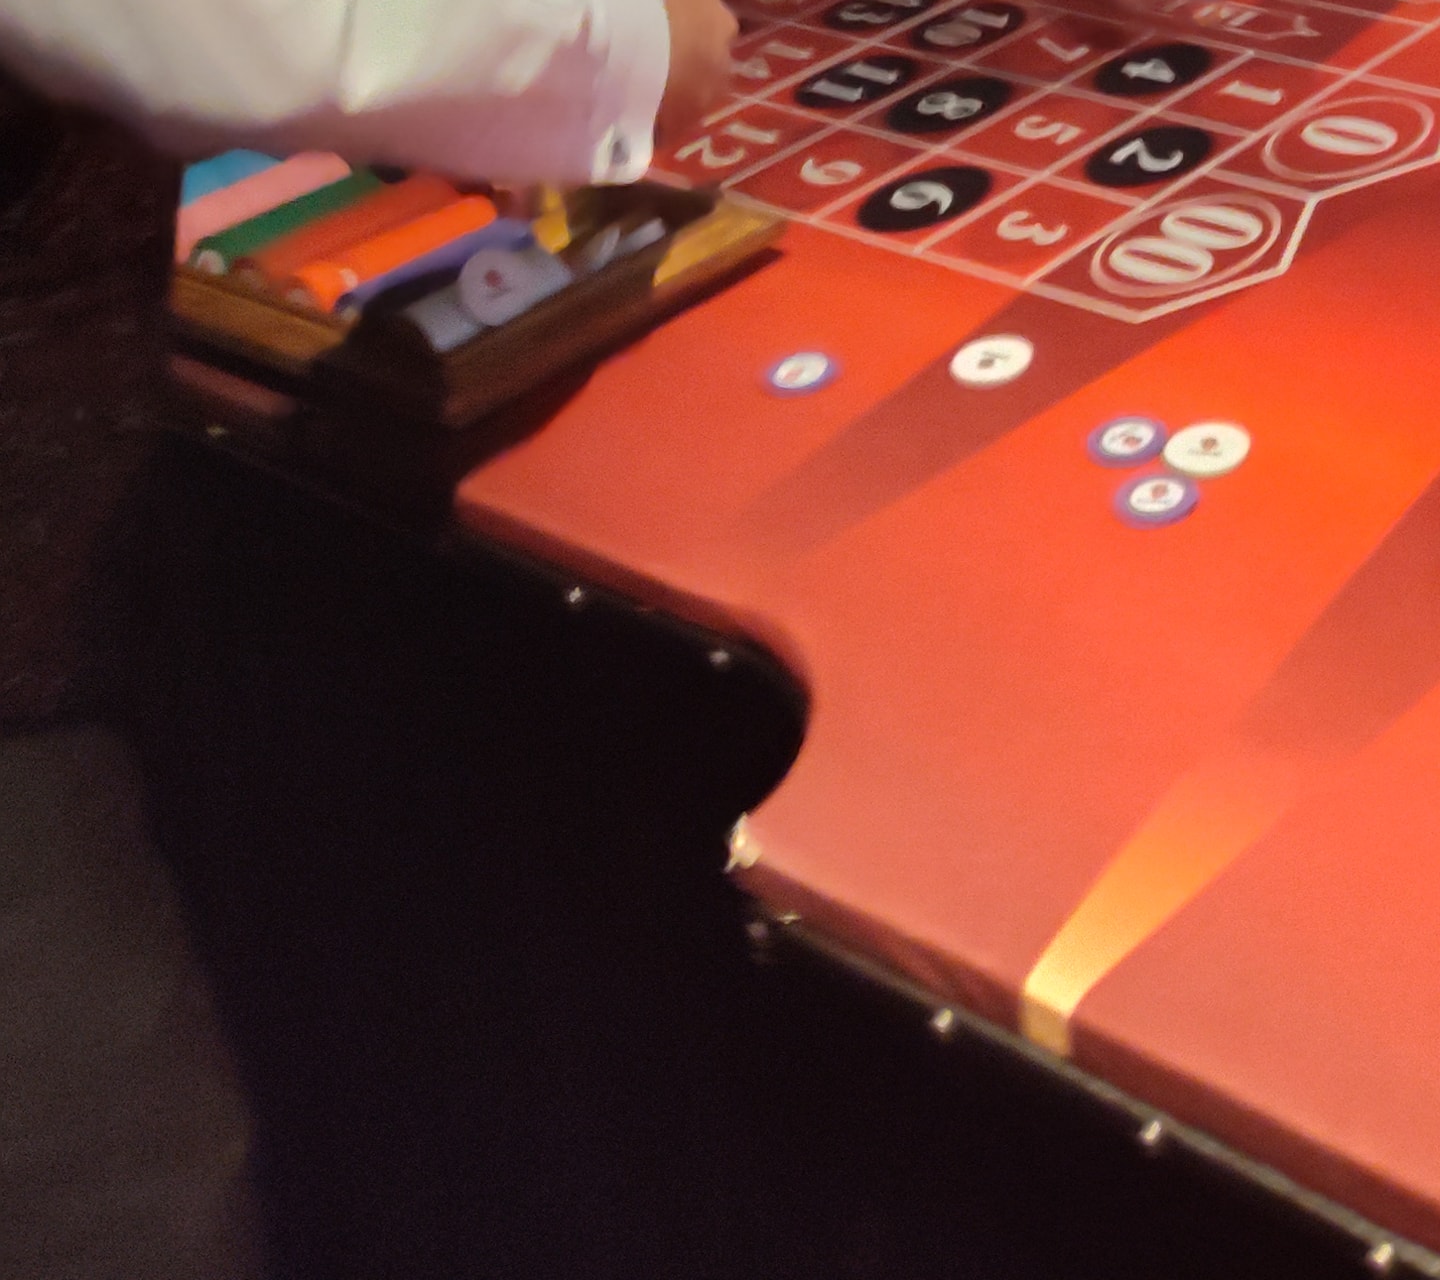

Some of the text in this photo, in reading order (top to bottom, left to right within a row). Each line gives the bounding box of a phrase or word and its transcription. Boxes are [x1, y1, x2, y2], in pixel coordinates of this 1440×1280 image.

[922, 8, 1010, 47] 10
[1035, 36, 1091, 64] 7
[808, 61, 899, 103] 11
[1120, 56, 1177, 85] 4
[916, 91, 984, 121] 8
[1218, 79, 1285, 107] 1
[673, 120, 781, 168] 12
[1013, 114, 1087, 147] 5
[1299, 115, 1399, 157] 0
[799, 156, 864, 186] 9
[1108, 136, 1185, 174] 2
[888, 179, 955, 216] 6
[995, 209, 1071, 246] 3
[1107, 204, 1265, 285] 00
